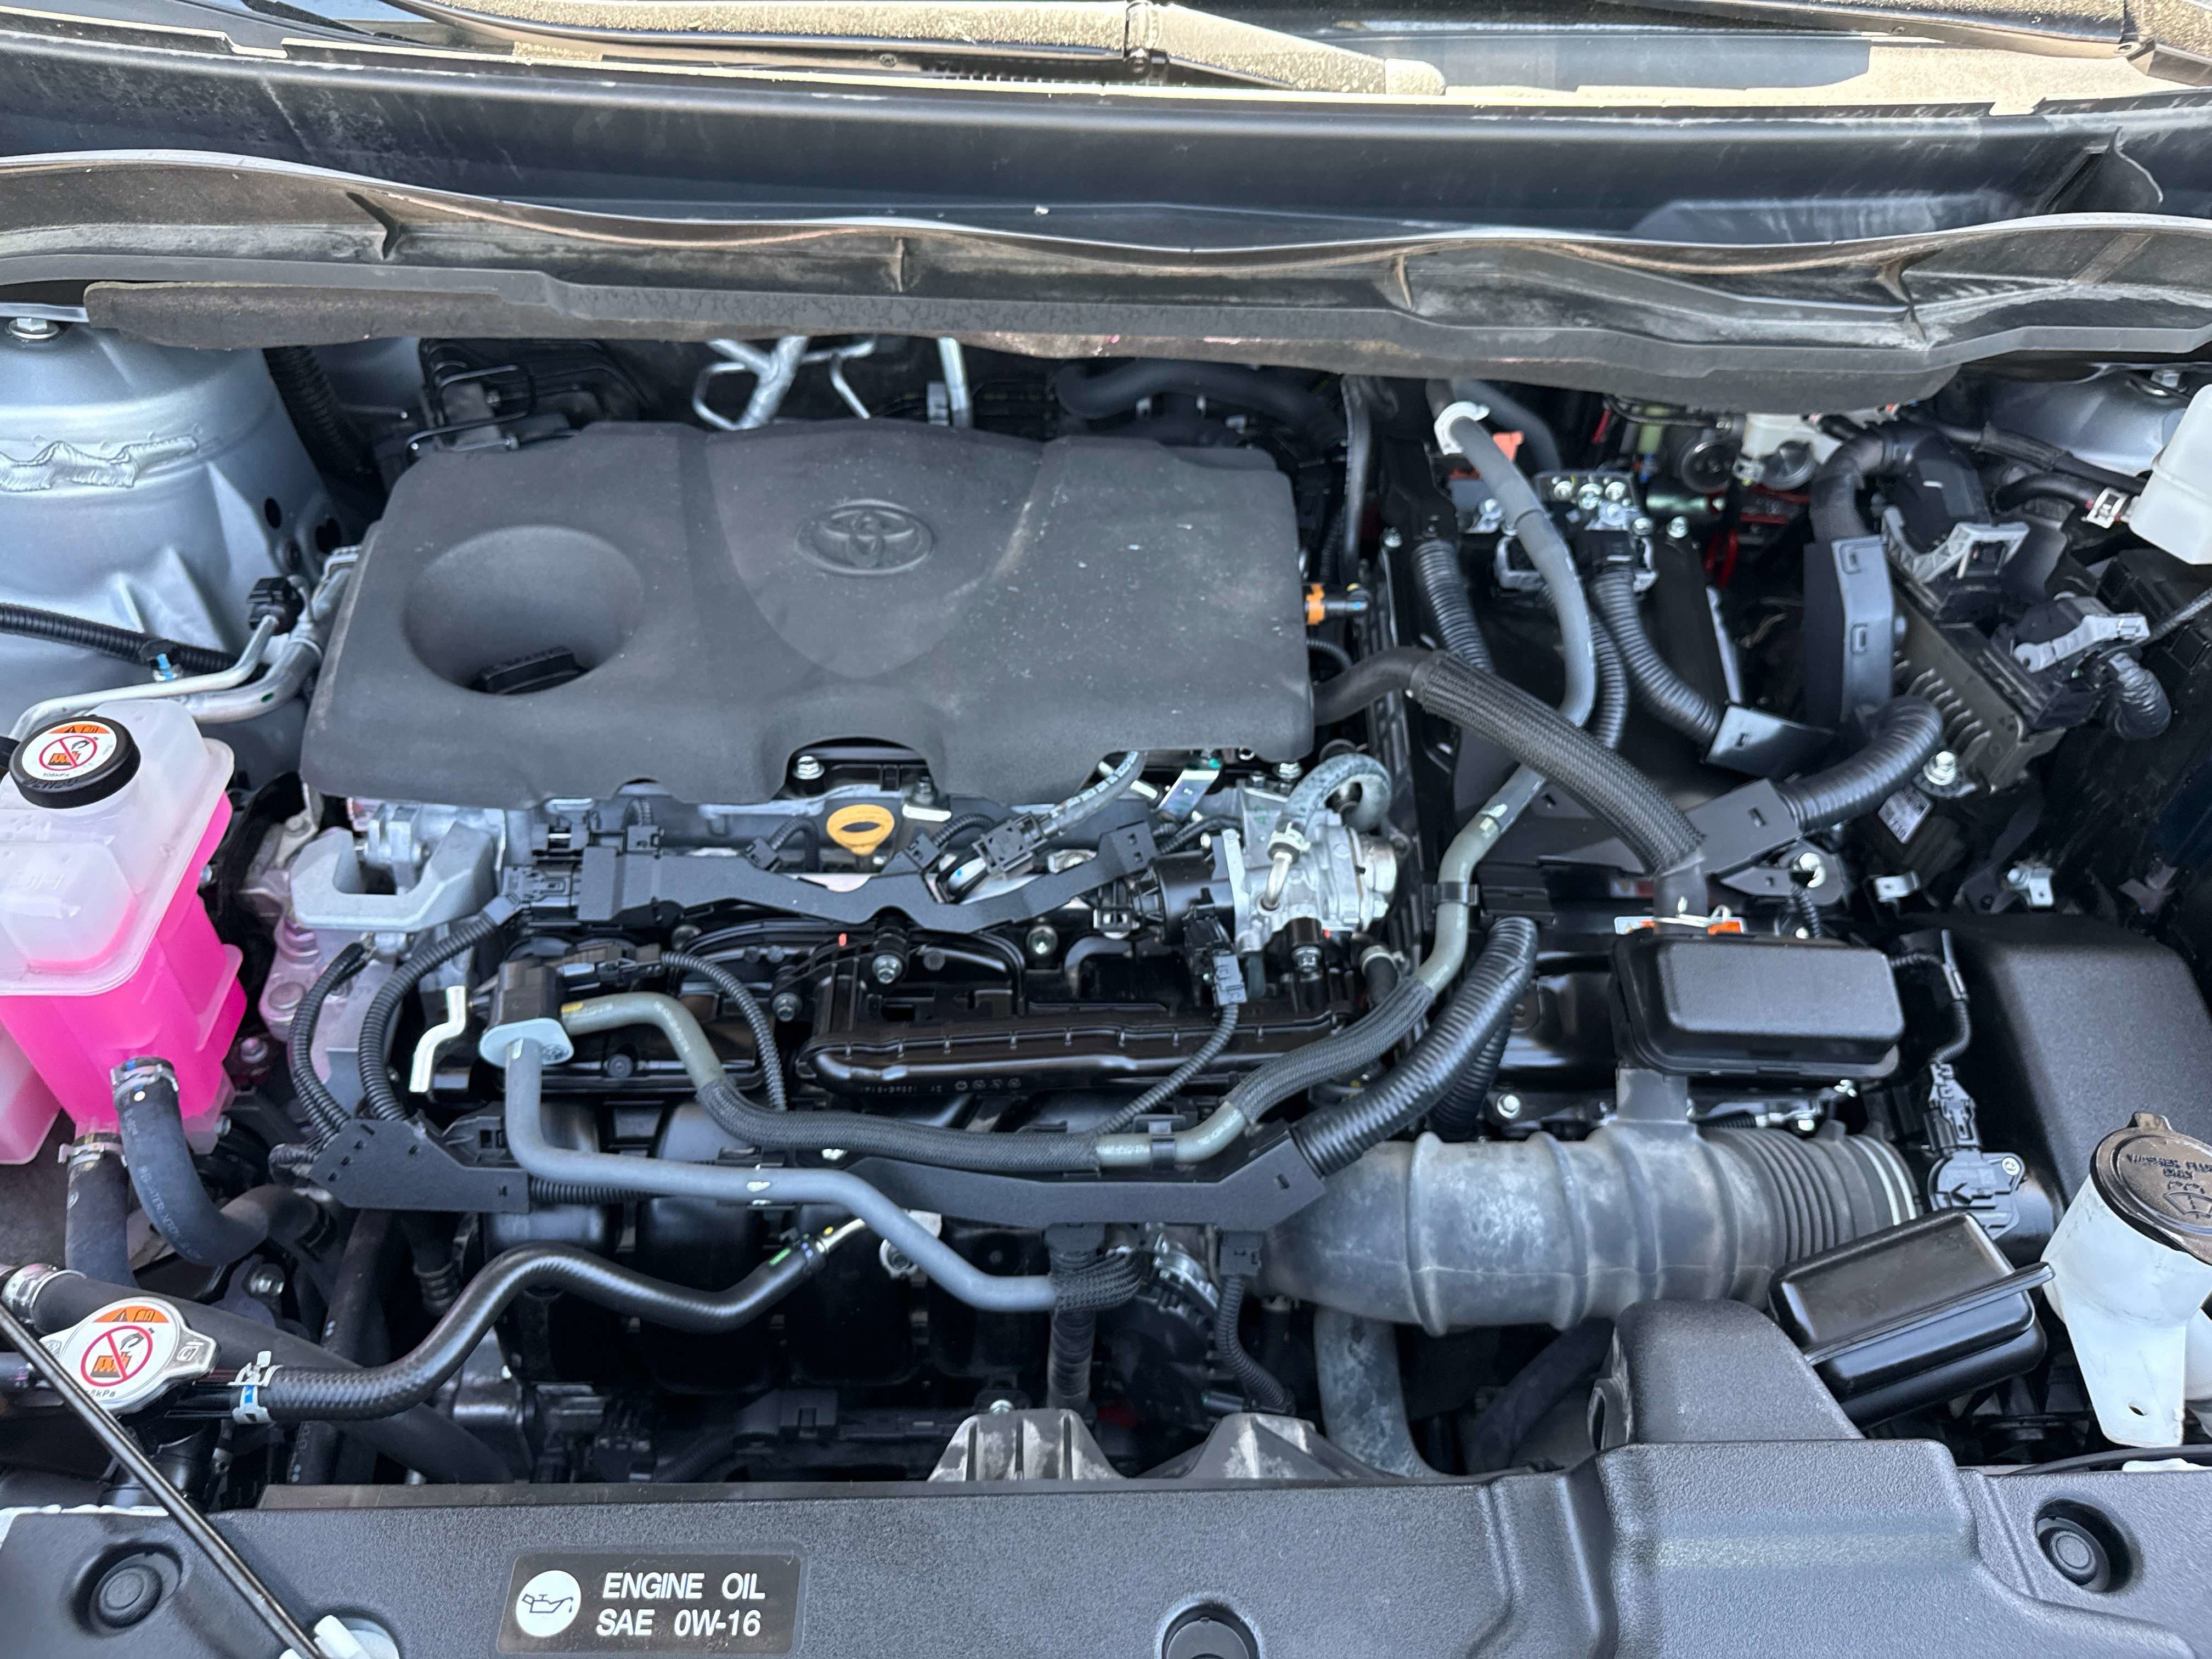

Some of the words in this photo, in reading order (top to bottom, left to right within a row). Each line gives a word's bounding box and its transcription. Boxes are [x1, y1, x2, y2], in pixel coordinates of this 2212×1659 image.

[602, 1572, 705, 1599] ENGINE
[721, 1572, 766, 1600] OIL
[596, 1608, 655, 1636] SAE
[674, 1609, 761, 1637] 0W-16
